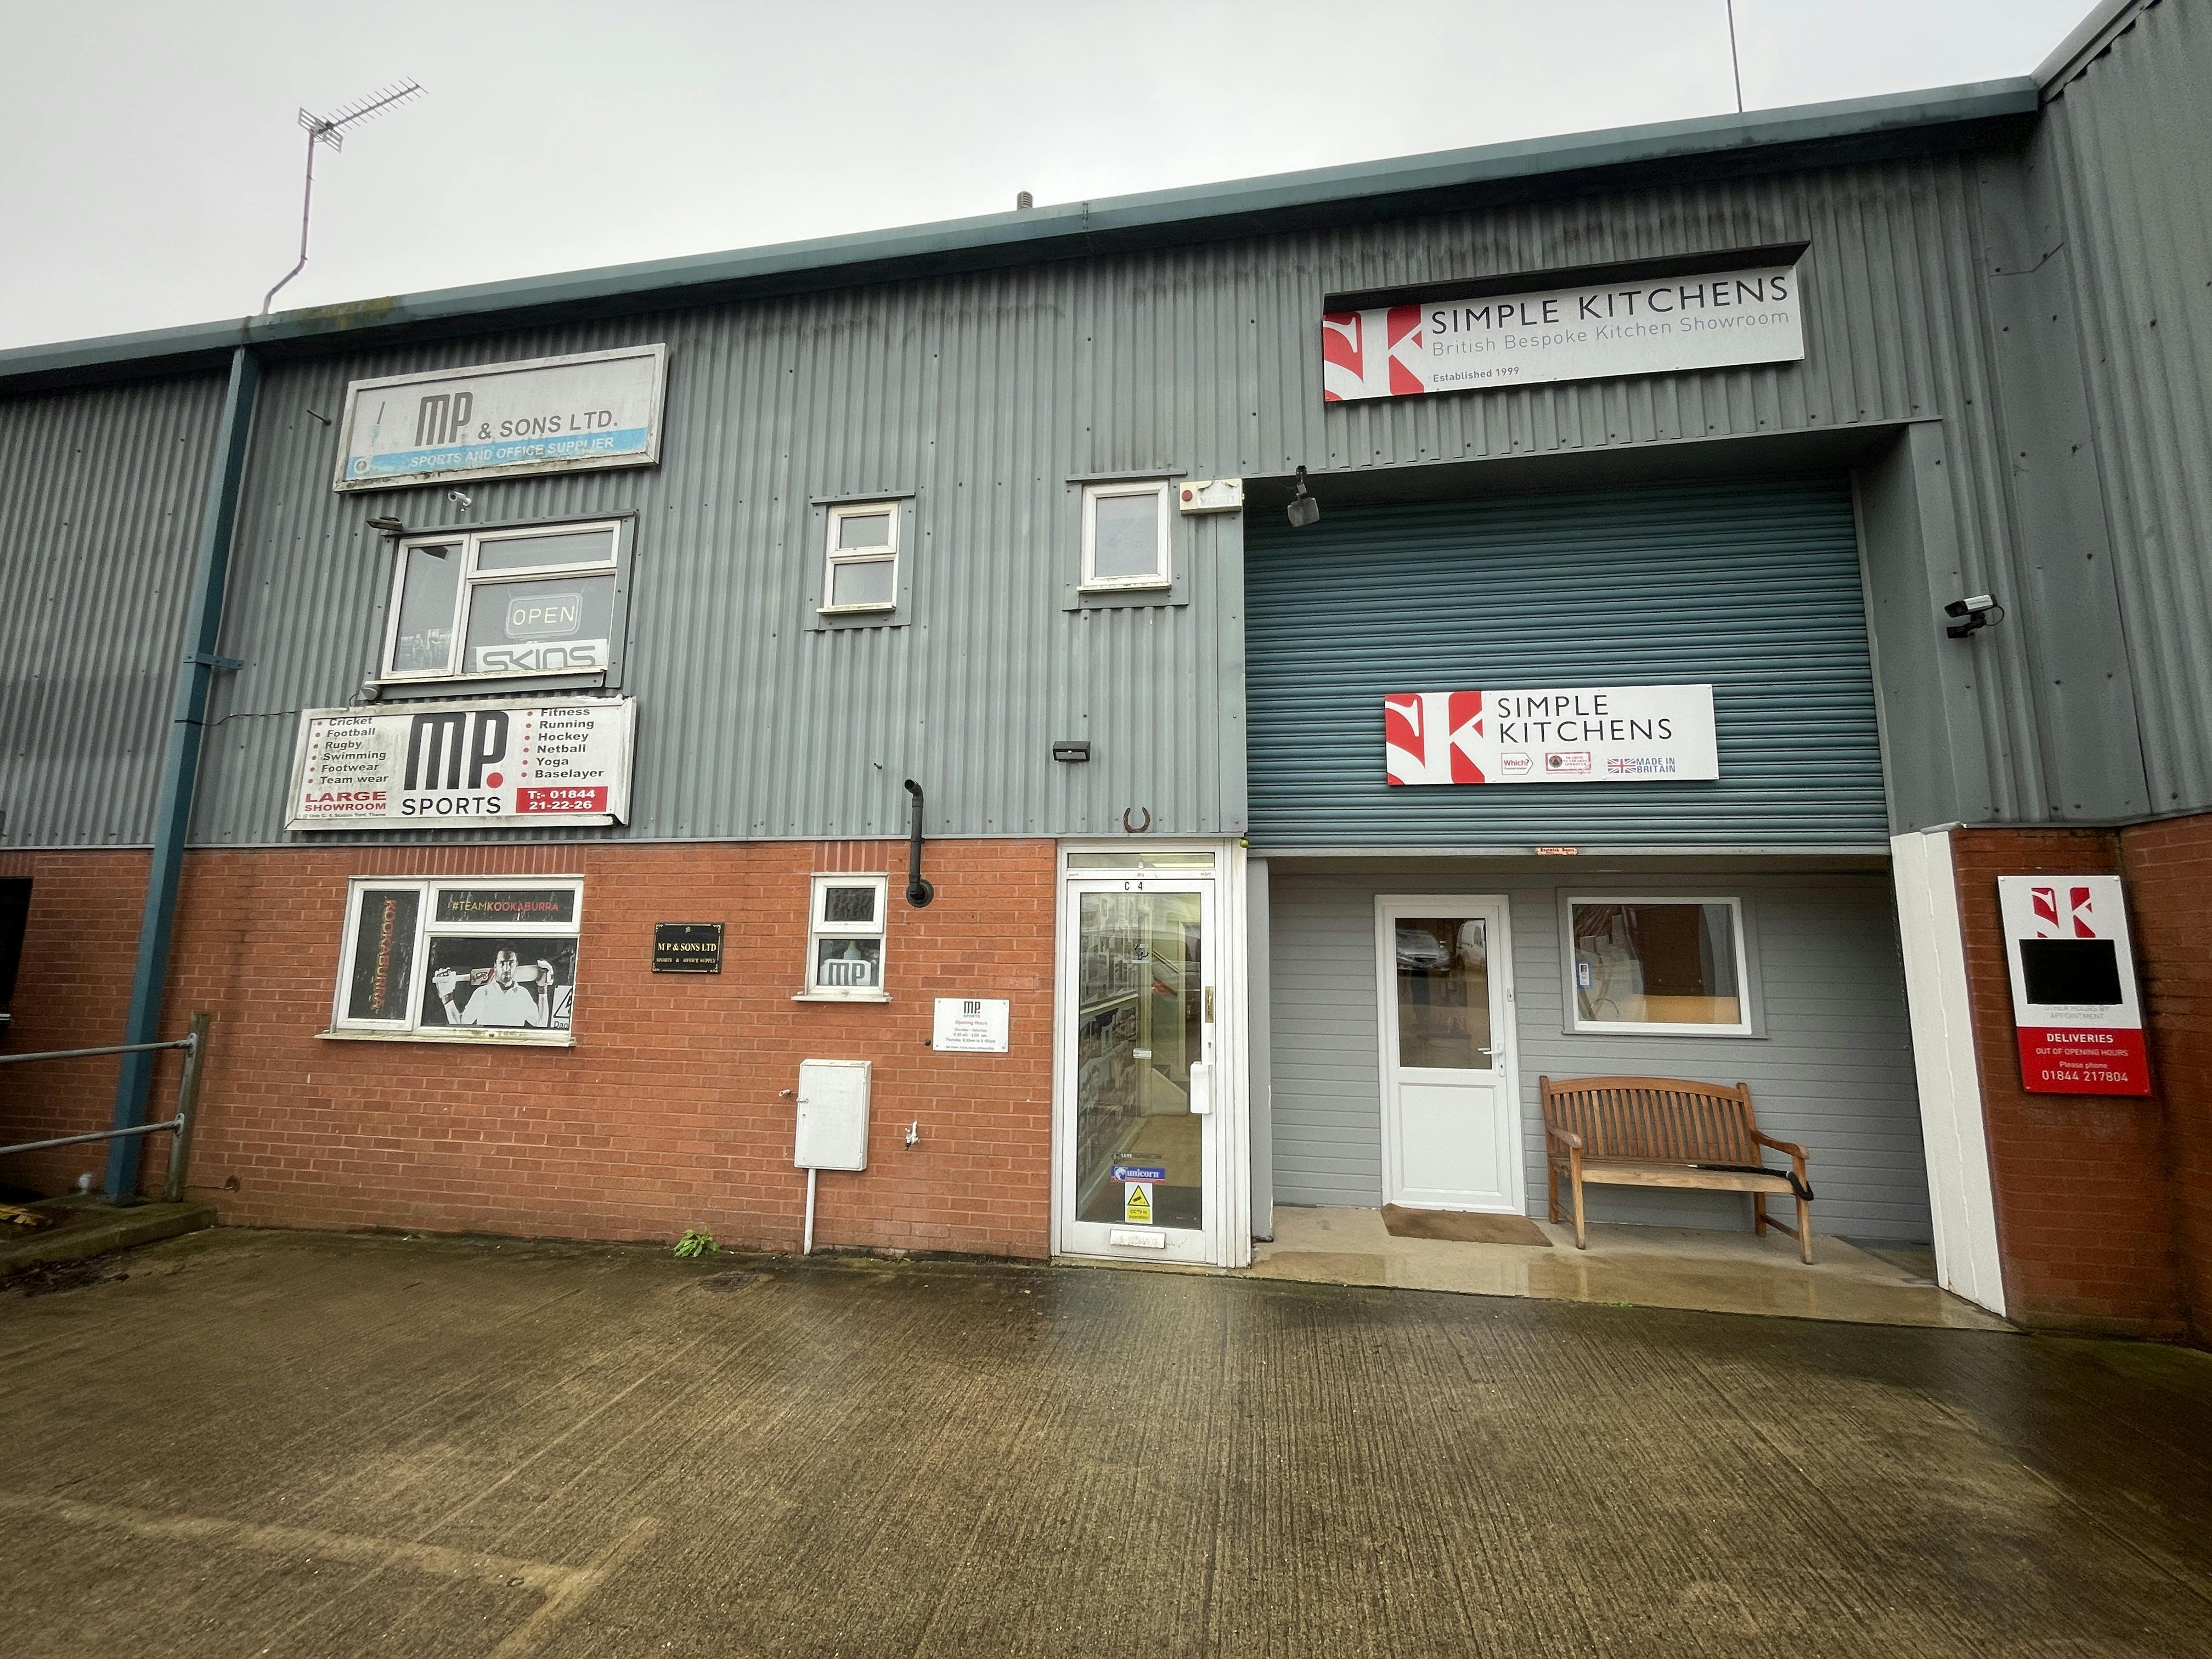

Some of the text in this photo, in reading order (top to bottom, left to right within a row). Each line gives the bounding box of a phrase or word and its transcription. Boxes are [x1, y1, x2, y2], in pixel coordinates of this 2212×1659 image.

[1432, 276, 1787, 335] SIMPLE KITCHENS
[1432, 312, 1789, 356] British Bespoke Kitchen Showroom
[1433, 367, 1520, 382] Established 1999
[415, 392, 618, 447] MP & SONS LTD.
[411, 437, 614, 467] SPORTS AND OFFICE SUPPLIER
[513, 605, 575, 625] OPEN
[1498, 695, 1609, 718] SIMPLE
[541, 708, 590, 717] Fitness
[329, 717, 373, 726] Cricket
[539, 720, 594, 730] Running
[327, 727, 376, 737] Football
[1500, 719, 1672, 743] KITCHENS
[538, 732, 589, 742] Hockey
[325, 741, 362, 750] Rugby
[537, 744, 586, 753] Netball
[323, 751, 386, 760] Swimming
[536, 758, 569, 768] Yoga
[535, 769, 605, 779] Baselayer
[1637, 765, 1675, 773] BRITAIN
[306, 791, 387, 803] LARGE
[550, 789, 596, 799] 01844
[305, 803, 386, 811] SHOWROOM
[401, 797, 501, 815] SPORTS
[529, 800, 592, 810] 21-22-26
[1125, 882, 1143, 890] C 4
[452, 901, 559, 911] #TEAMKOOKABURRA
[680, 943, 700, 951] SONS
[702, 943, 716, 951] LTD
[2046, 1033, 2114, 1043] DELIVERIES
[2042, 1070, 2128, 1082] 01844 217804
[1127, 1169, 1159, 1177] unicorn
